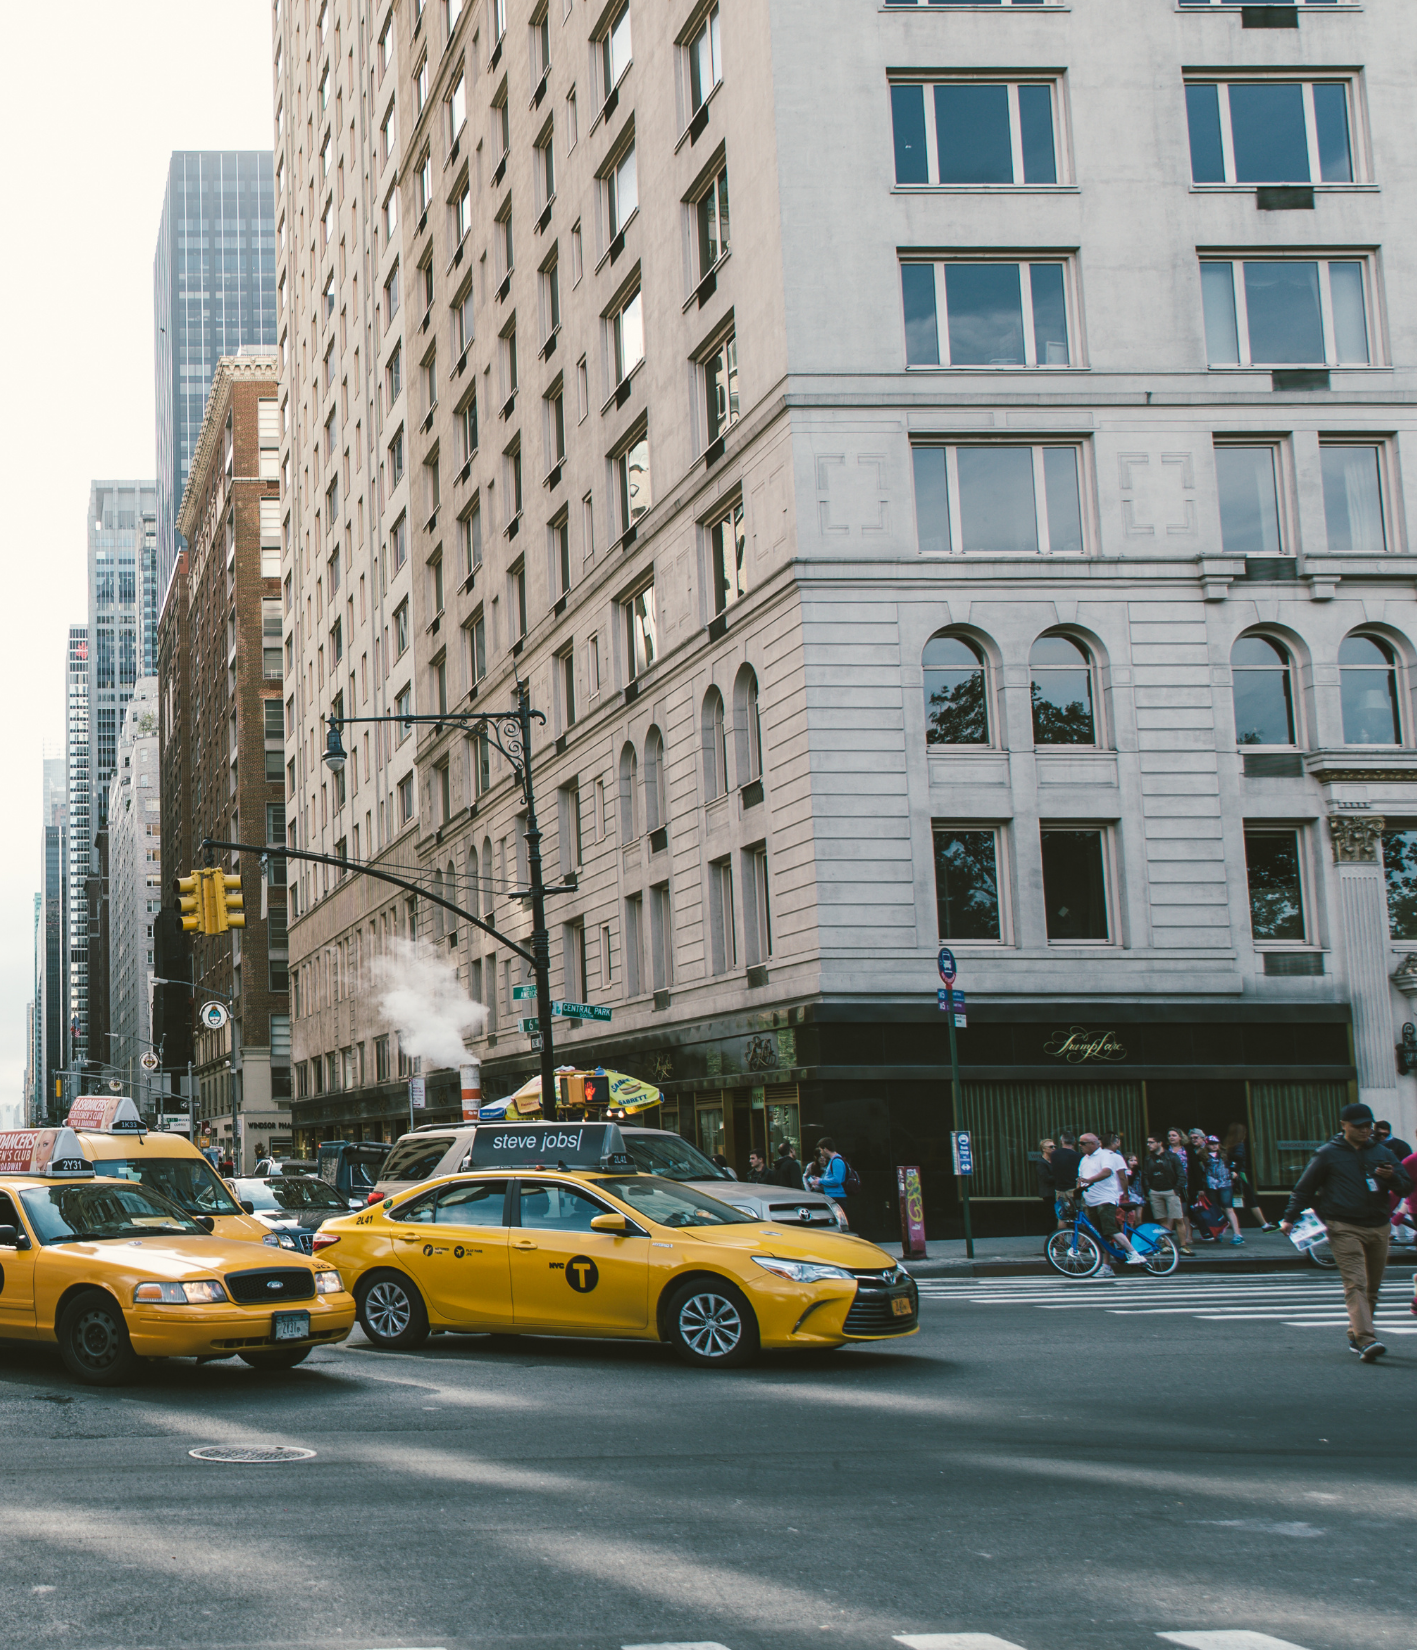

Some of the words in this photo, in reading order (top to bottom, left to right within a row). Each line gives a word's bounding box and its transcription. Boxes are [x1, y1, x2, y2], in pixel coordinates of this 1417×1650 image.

[563, 1003, 592, 1015] CENTRAL
[594, 1007, 611, 1016] PARK
[528, 1019, 533, 1030] 6
[618, 1094, 647, 1105] SABRETT
[493, 1133, 536, 1149] steve
[14, 1149, 32, 1161] CLUB
[63, 1159, 82, 1170] 2Y31
[356, 1215, 373, 1225] 2L41
[572, 1263, 591, 1288] T
